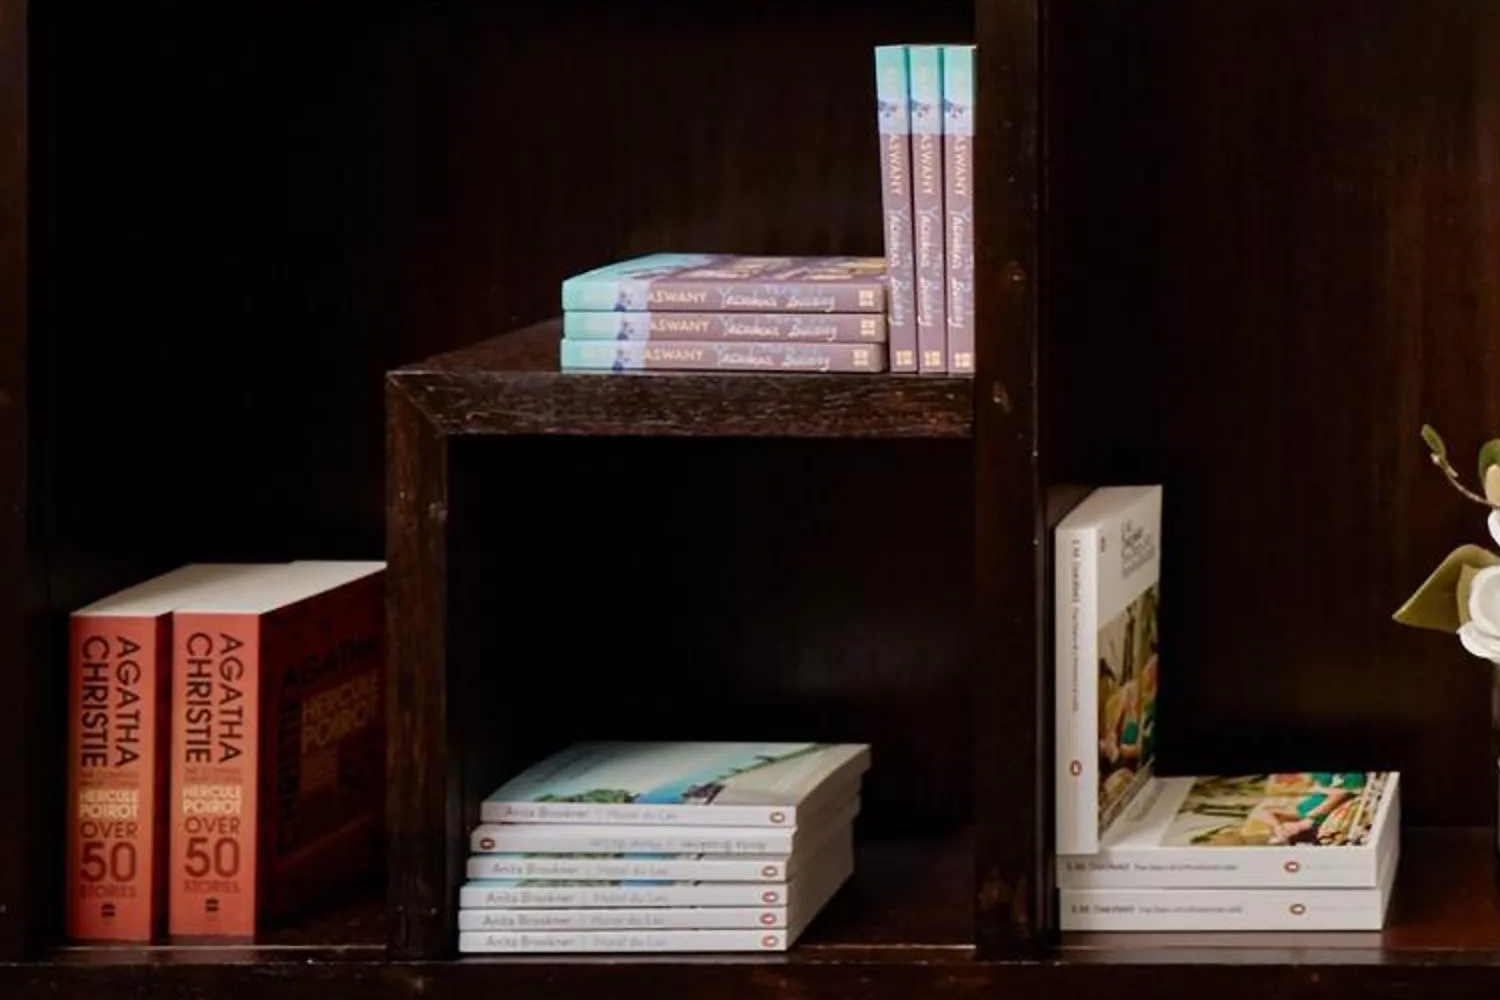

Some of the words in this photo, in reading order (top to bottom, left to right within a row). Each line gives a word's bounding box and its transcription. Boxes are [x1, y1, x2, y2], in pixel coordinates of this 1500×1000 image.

[82, 636, 109, 768] CHRISTIE
[115, 636, 140, 768] AGATHA
[186, 633, 213, 763] CHRISTIE
[219, 633, 244, 763] AGATHA
[80, 821, 137, 838] OVER
[81, 842, 136, 882] 50
[185, 817, 240, 834] OVER
[185, 837, 239, 877] 50
